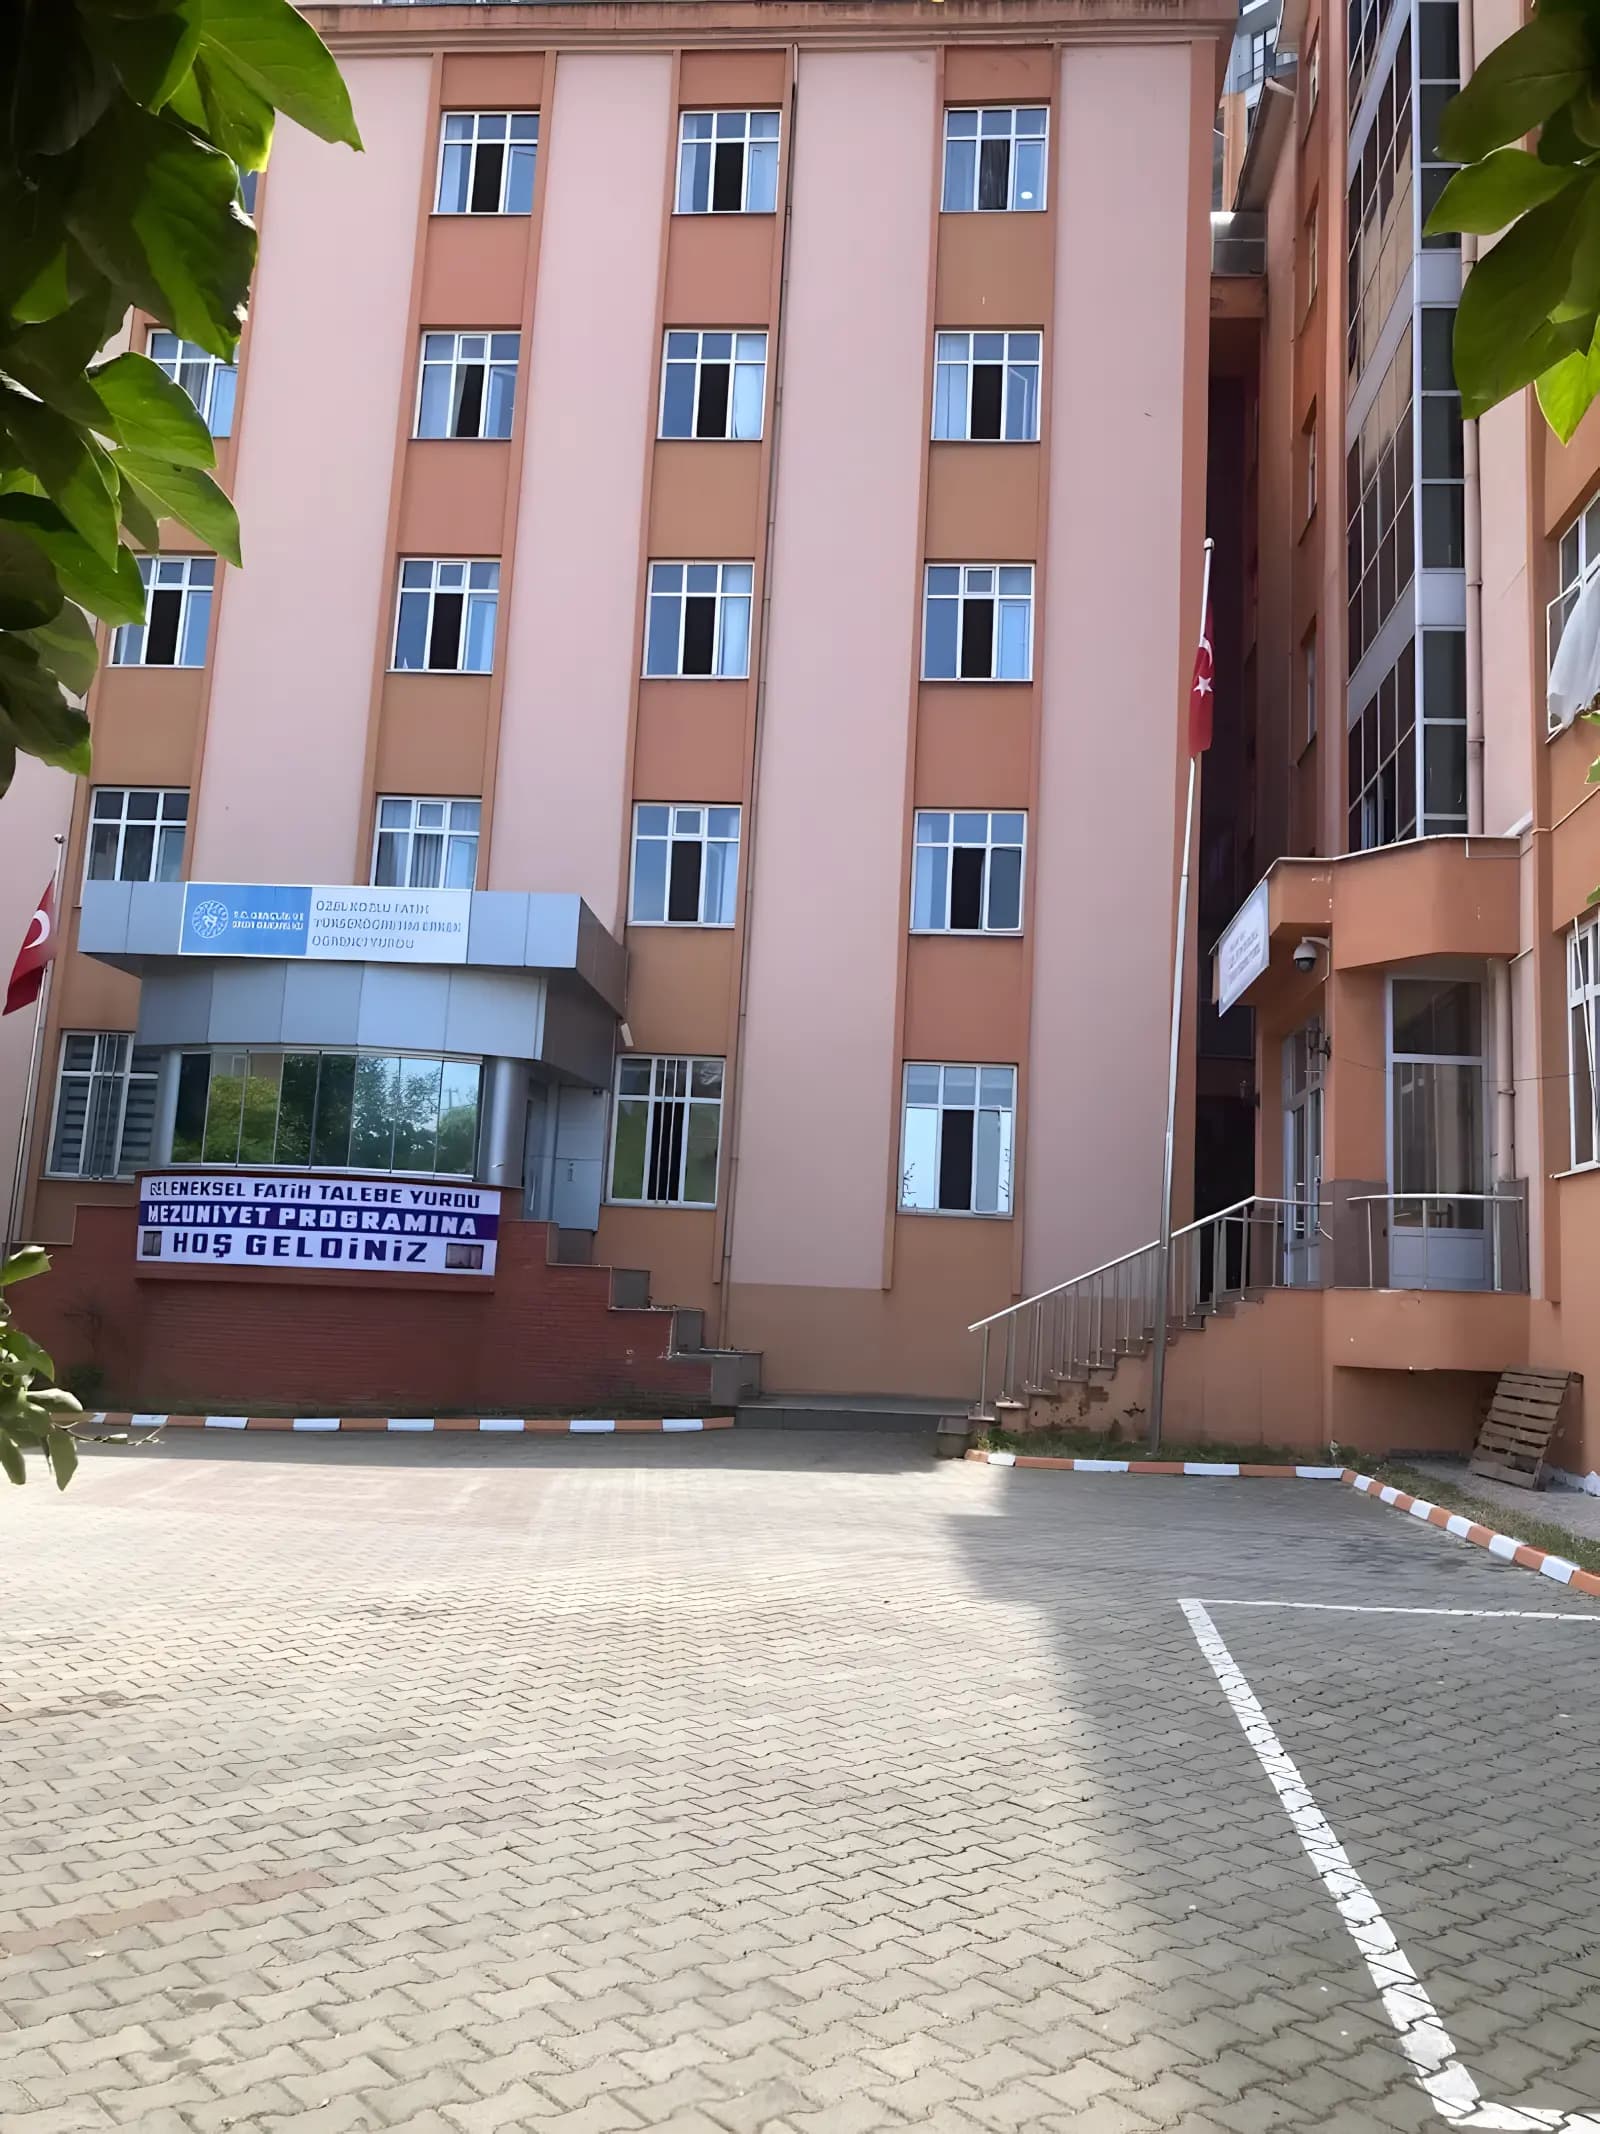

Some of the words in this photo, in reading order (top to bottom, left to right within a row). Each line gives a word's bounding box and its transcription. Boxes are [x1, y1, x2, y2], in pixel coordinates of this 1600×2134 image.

[319, 1185, 402, 1204] TALEBE
[410, 1190, 480, 1209] YURDU
[278, 1207, 477, 1236] PROGRAMINA
[173, 1232, 233, 1258] HOŞ
